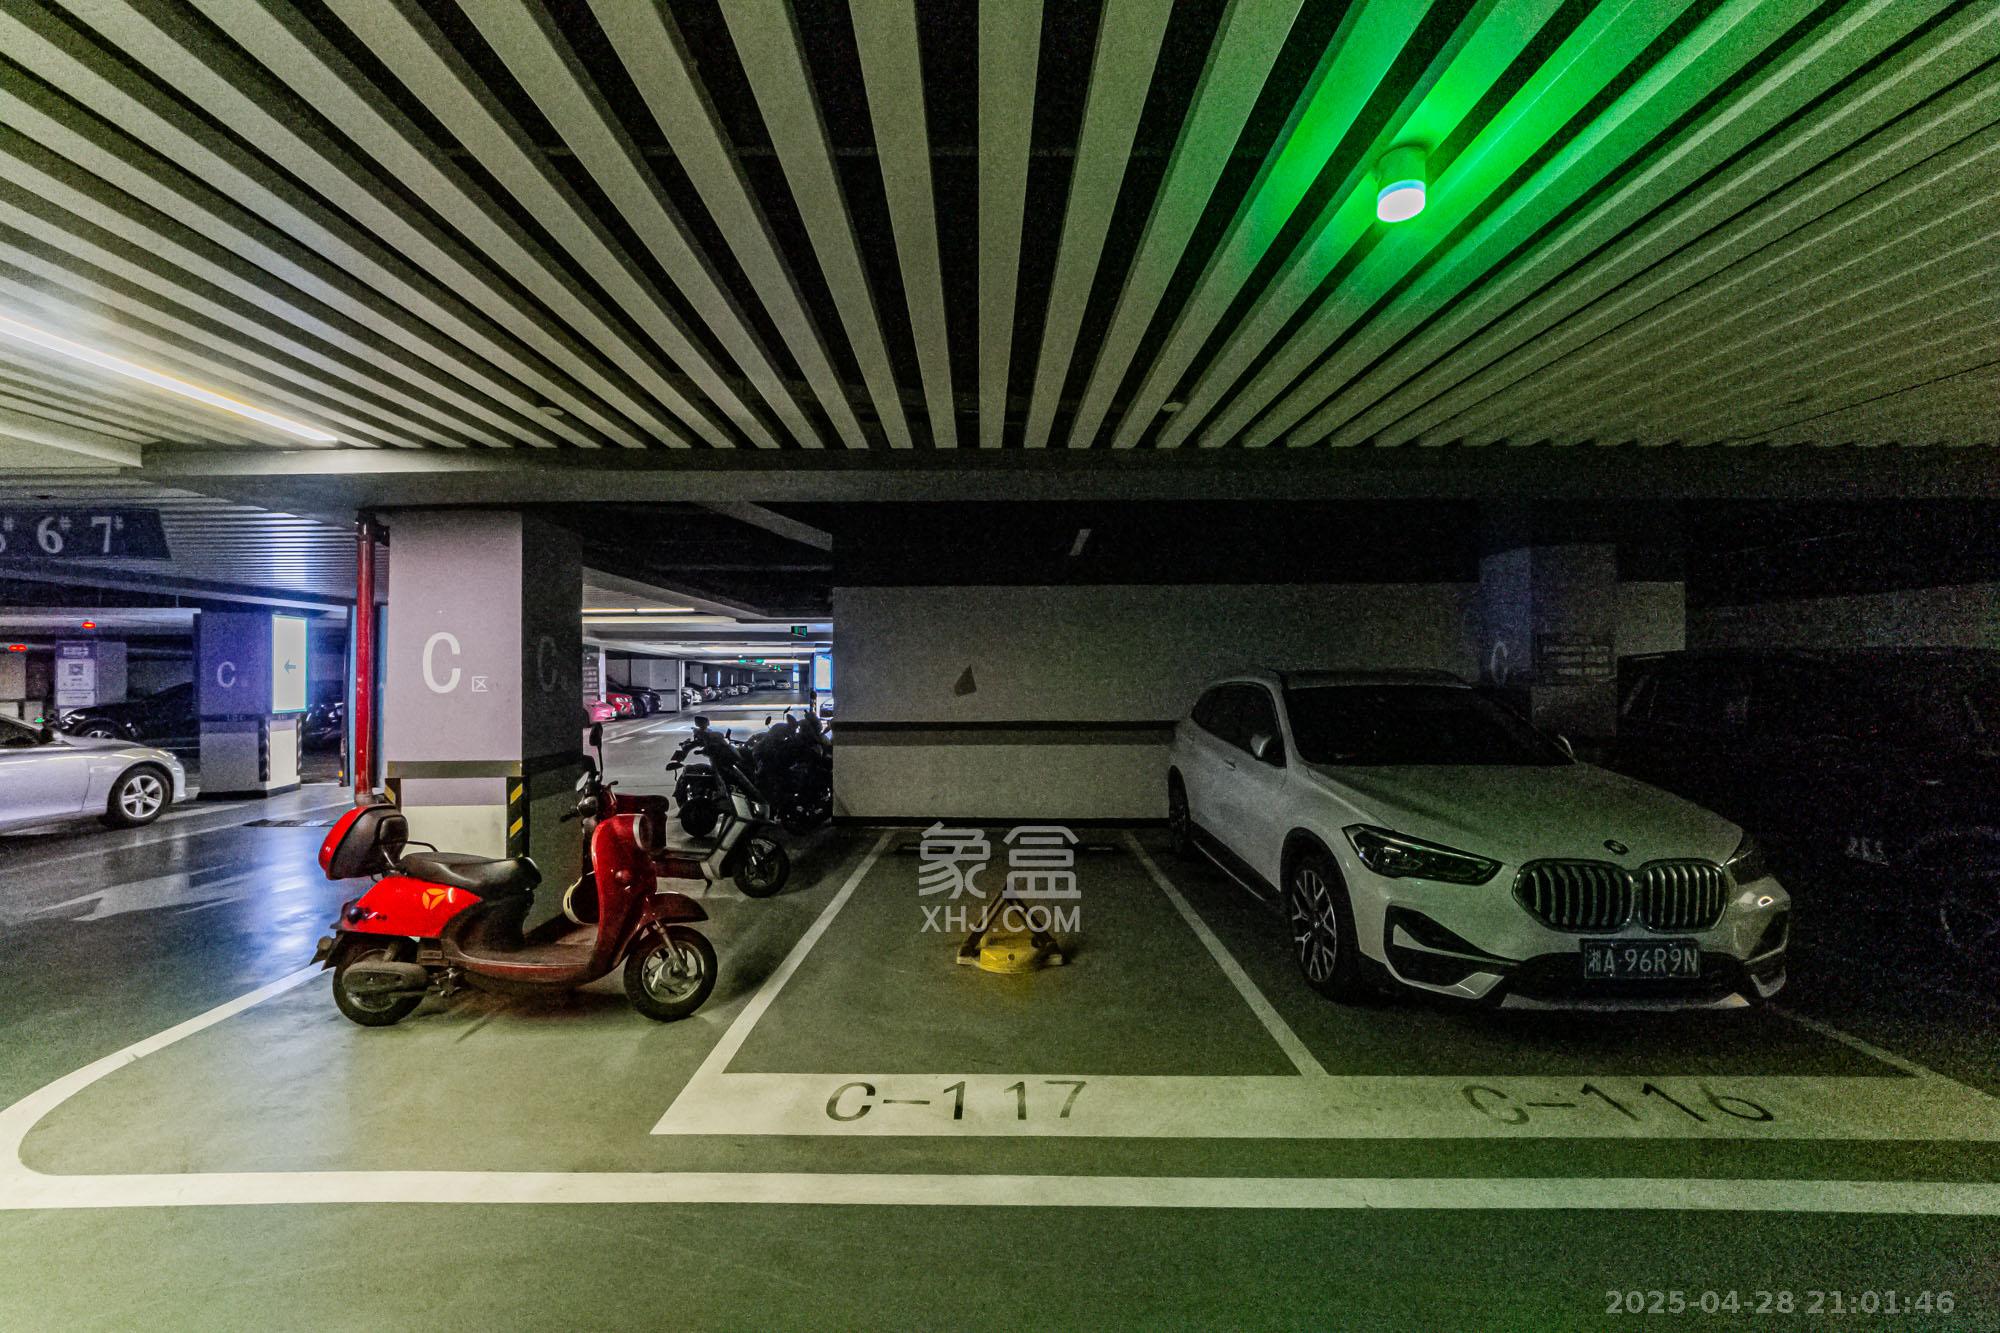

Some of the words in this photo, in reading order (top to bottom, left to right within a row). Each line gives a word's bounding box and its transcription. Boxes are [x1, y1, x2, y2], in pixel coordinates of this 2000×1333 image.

[217, 661, 236, 688] C
[422, 632, 461, 694] C
[825, 1081, 1088, 1122] C-117
